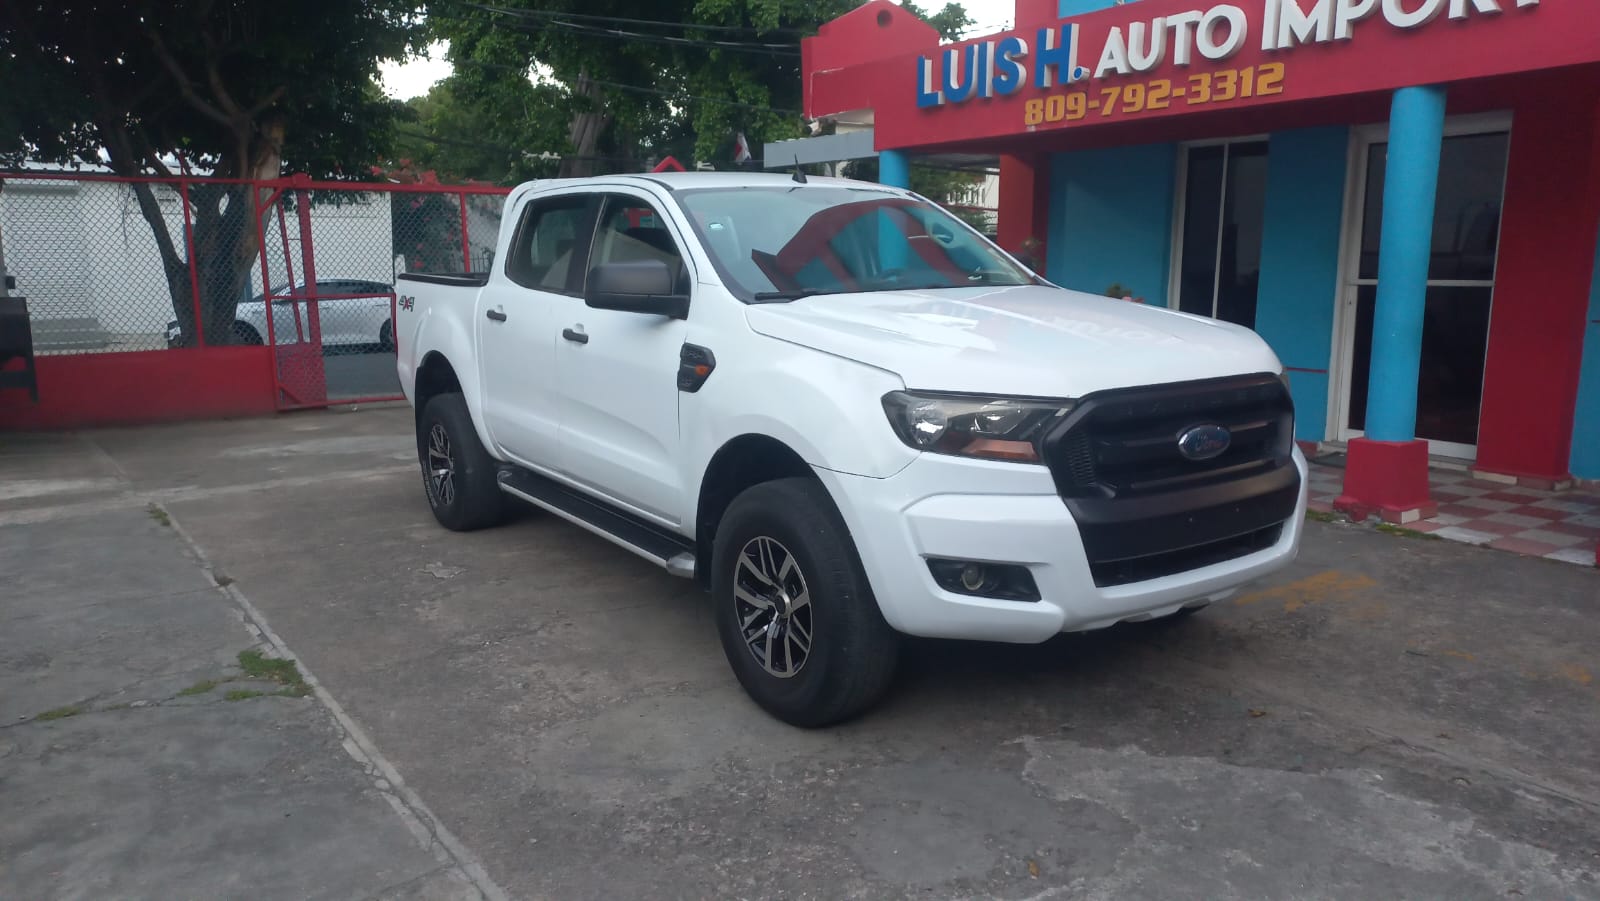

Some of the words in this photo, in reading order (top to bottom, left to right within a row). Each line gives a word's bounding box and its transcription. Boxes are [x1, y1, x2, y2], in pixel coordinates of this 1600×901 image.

[917, 37, 1028, 108] LUIS
[1034, 23, 1090, 88] H.
[1094, 4, 1248, 78] AUTO
[1261, 0, 1540, 50] IMP
[1024, 62, 1285, 126] 809-792-3312
